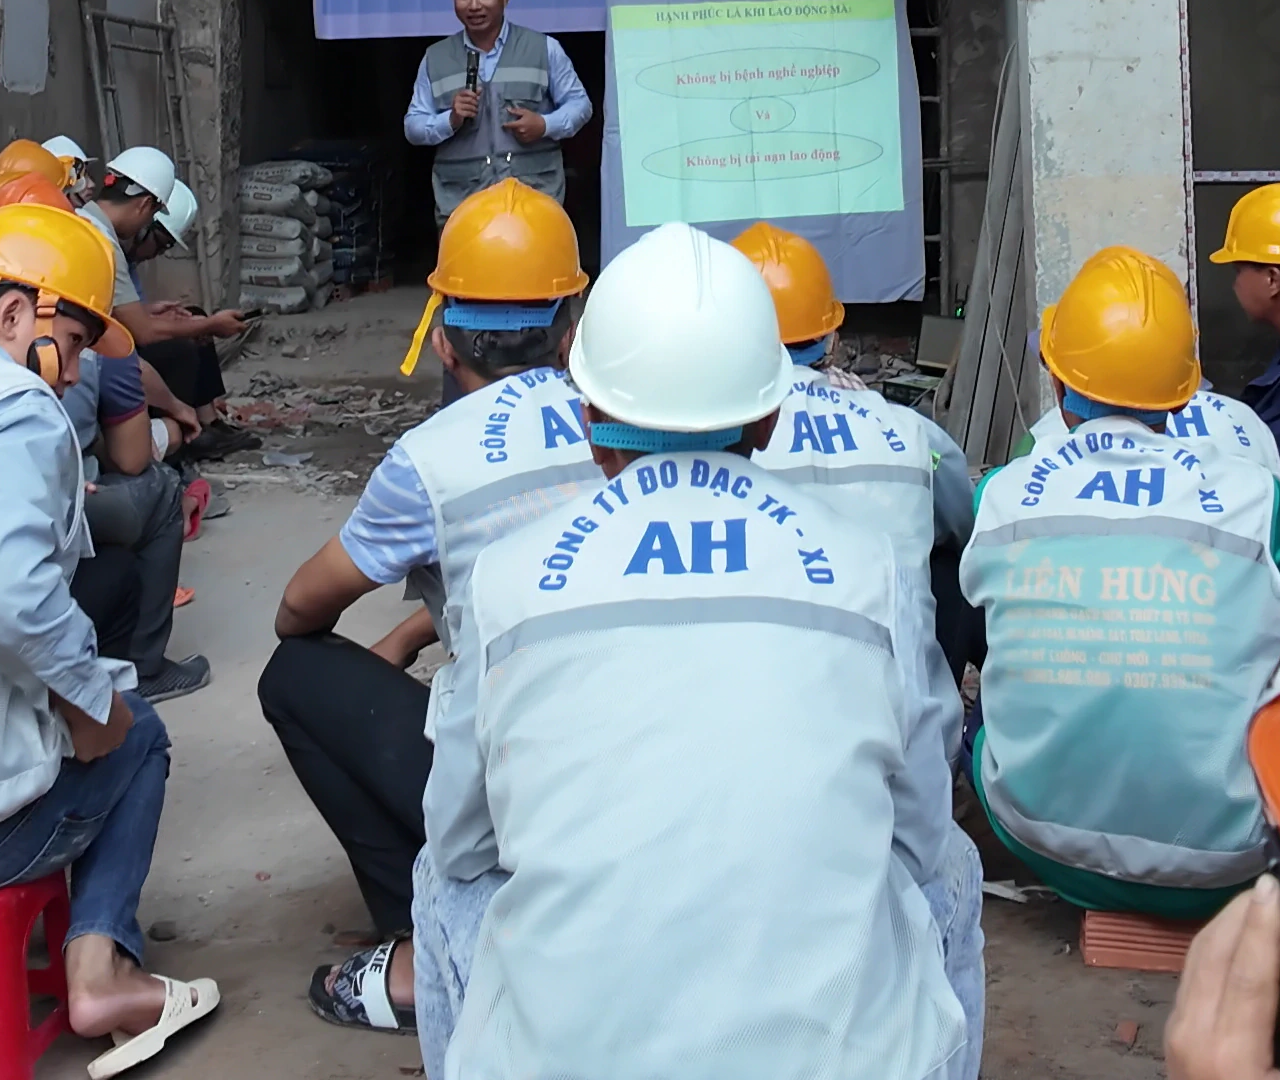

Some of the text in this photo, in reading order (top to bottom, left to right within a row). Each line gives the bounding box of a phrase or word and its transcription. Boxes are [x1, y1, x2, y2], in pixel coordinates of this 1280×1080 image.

[744, 6, 767, 18] KHI
[768, 5, 792, 17] LAO
[794, 3, 828, 19] ĐỘNG
[675, 63, 841, 87] Không bị bệnh nghề nghiệp
[685, 153, 727, 168] Không
[729, 153, 742, 167] bị
[763, 152, 786, 165] nạn
[789, 149, 808, 161] lao
[810, 147, 841, 163] động
[494, 383, 522, 408] TY
[480, 412, 510, 463] CÔNG
[789, 410, 859, 454] AH
[882, 428, 906, 452] XD
[1233, 424, 1251, 447] XD
[1021, 457, 1060, 507] CÔNG
[1057, 439, 1084, 466] TY
[1085, 432, 1113, 454] ĐO
[1172, 448, 1201, 472] TK
[1198, 488, 1225, 513] XD
[1074, 467, 1167, 507] AH
[538, 459, 835, 591] CÔNG TY ĐO ĐẠC TK XD
[623, 518, 749, 577] AH
[1004, 556, 1216, 607] LIÊN HƯNG
